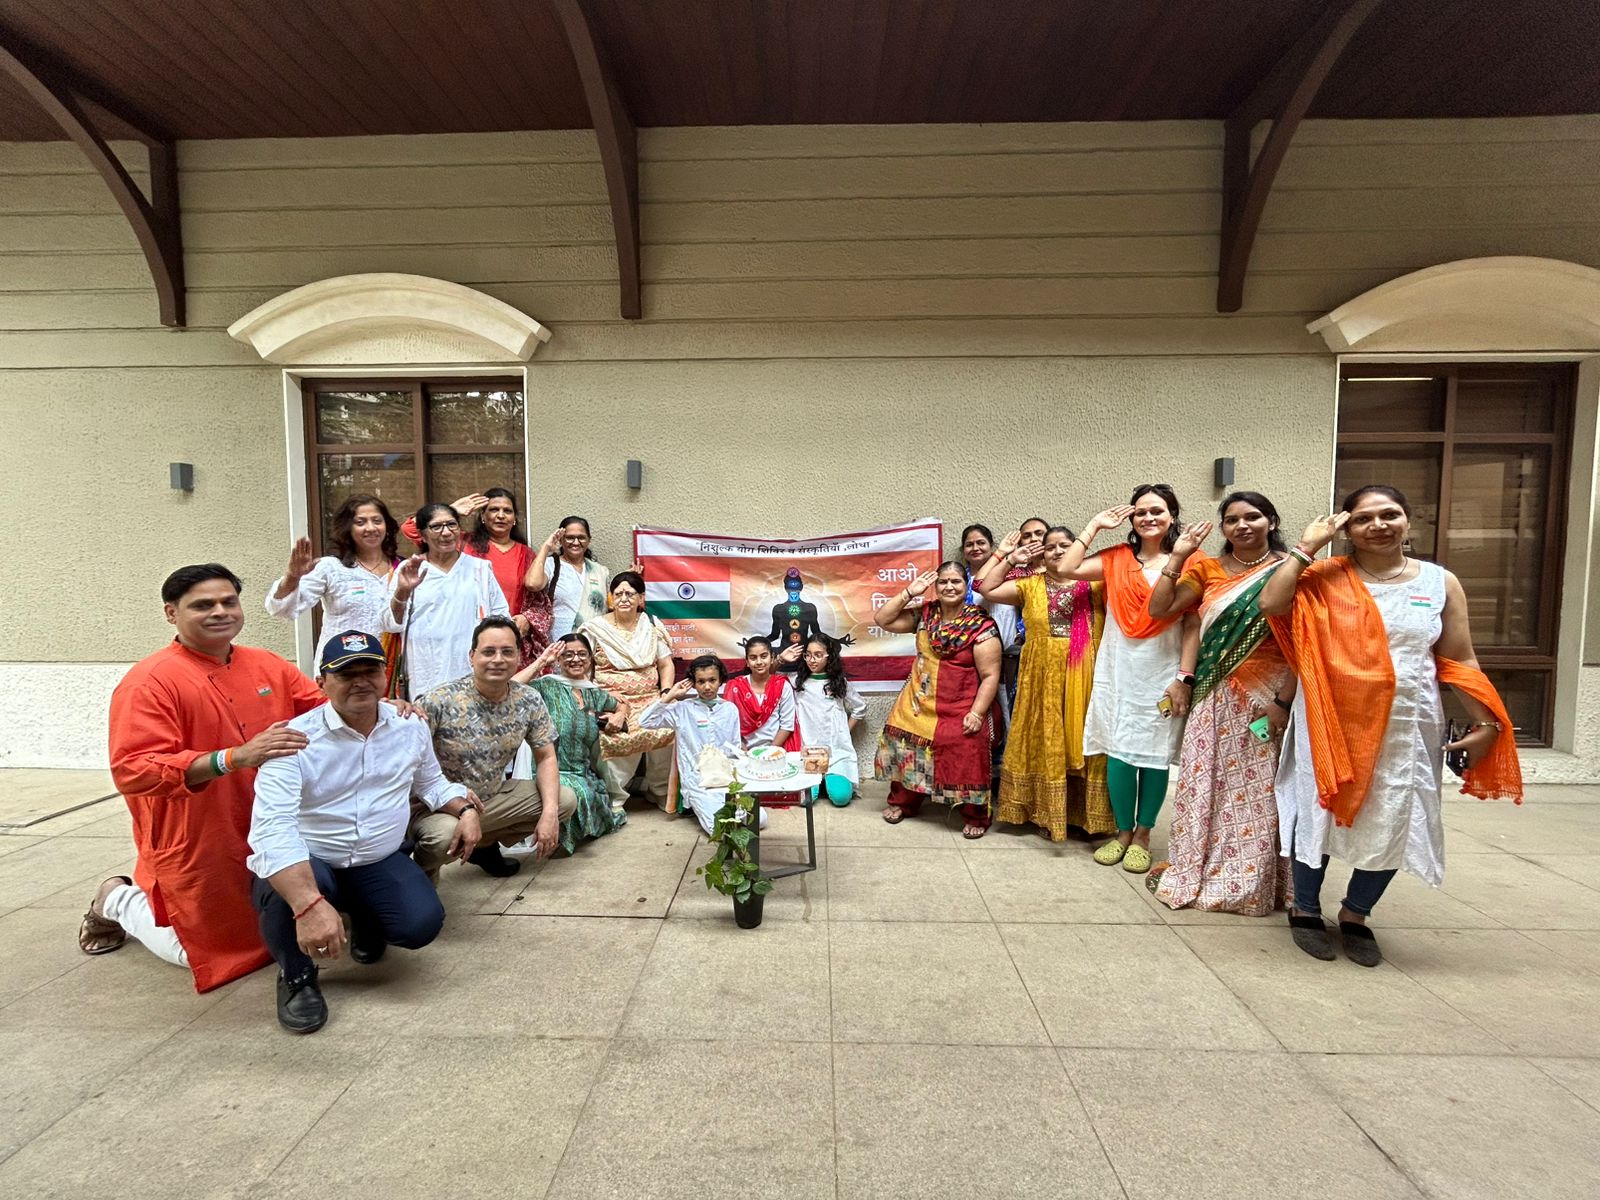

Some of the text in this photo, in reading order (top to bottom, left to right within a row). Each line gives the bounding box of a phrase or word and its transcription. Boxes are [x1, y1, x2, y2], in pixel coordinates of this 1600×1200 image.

[737, 543, 754, 553] योग
[757, 544, 785, 554] शिविर
[877, 562, 918, 582] आओ
